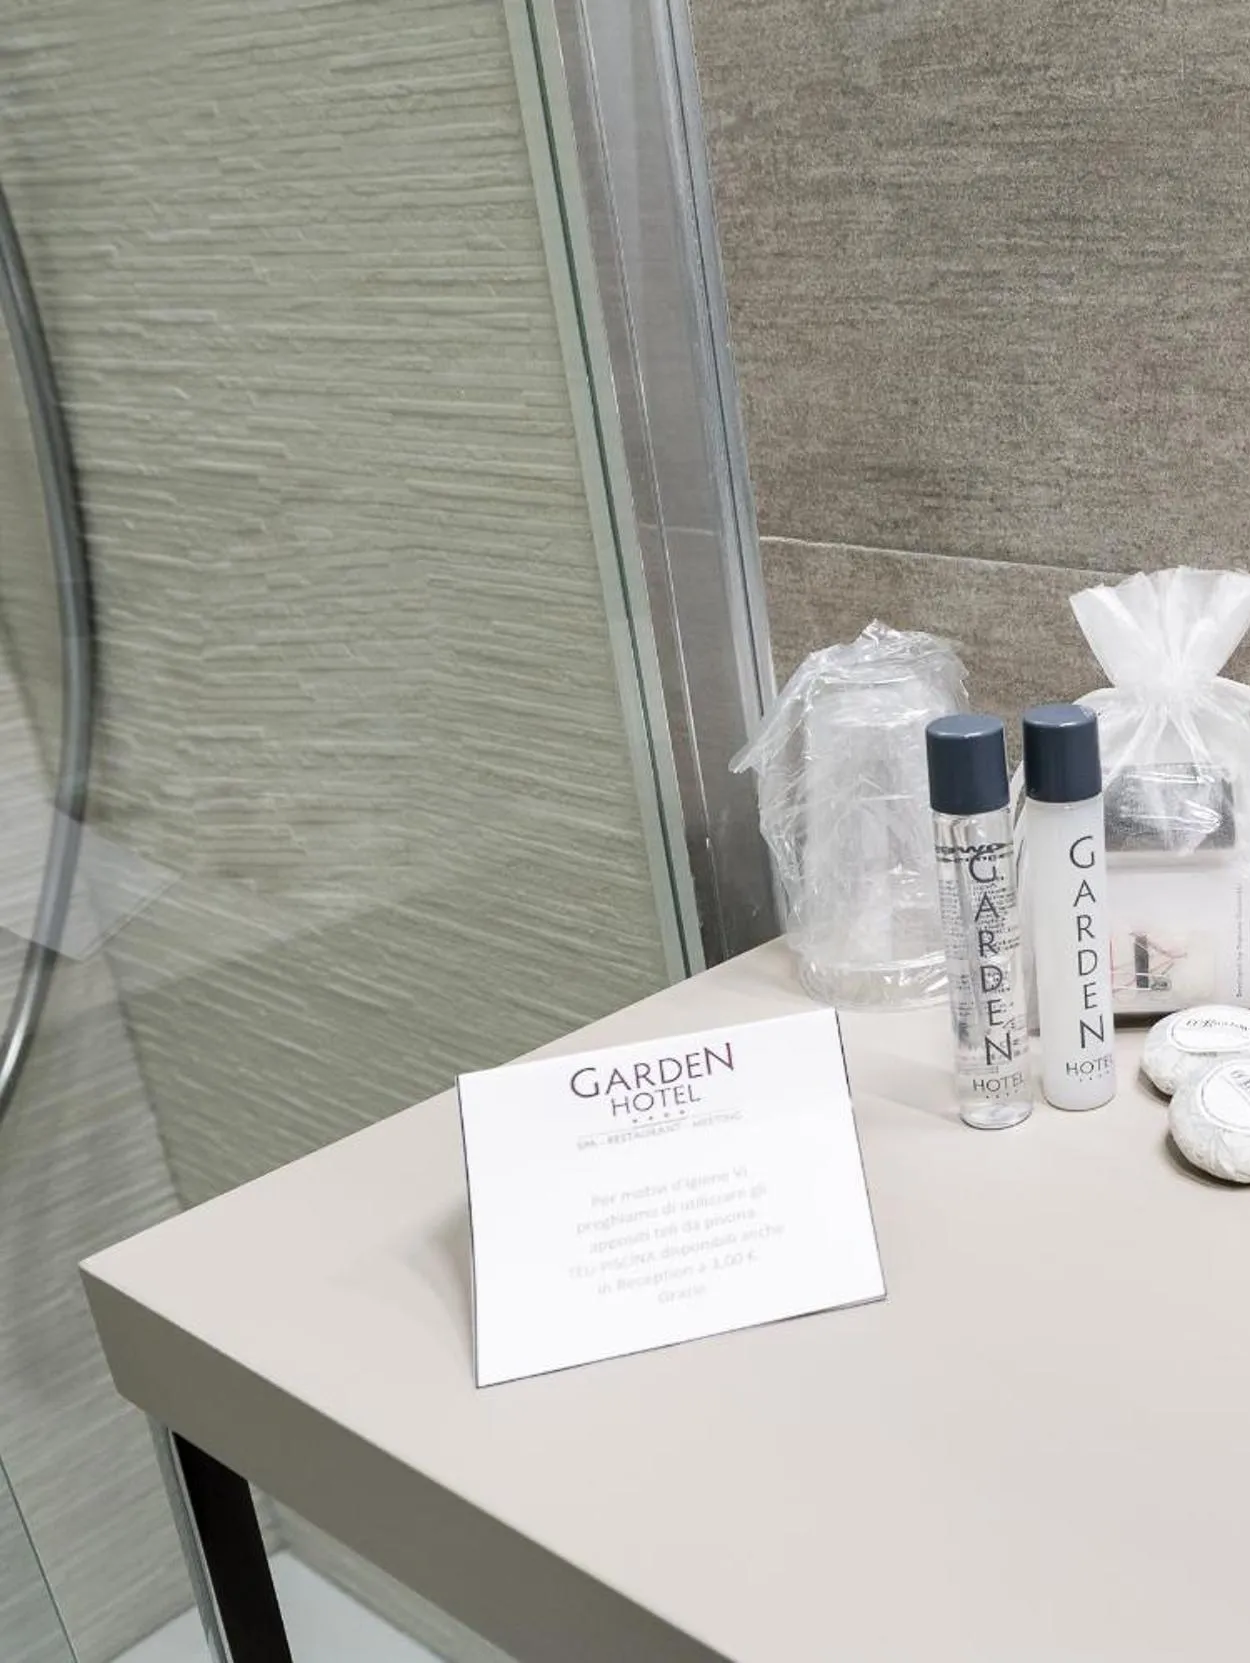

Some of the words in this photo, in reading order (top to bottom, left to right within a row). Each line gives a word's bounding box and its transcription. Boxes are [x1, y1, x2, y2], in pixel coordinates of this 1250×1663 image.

[968, 846, 1013, 1066] GARDEN
[1069, 835, 1105, 1049] GARDEN
[570, 1042, 735, 1099] GARDEN
[610, 1084, 702, 1117] HOTEL
